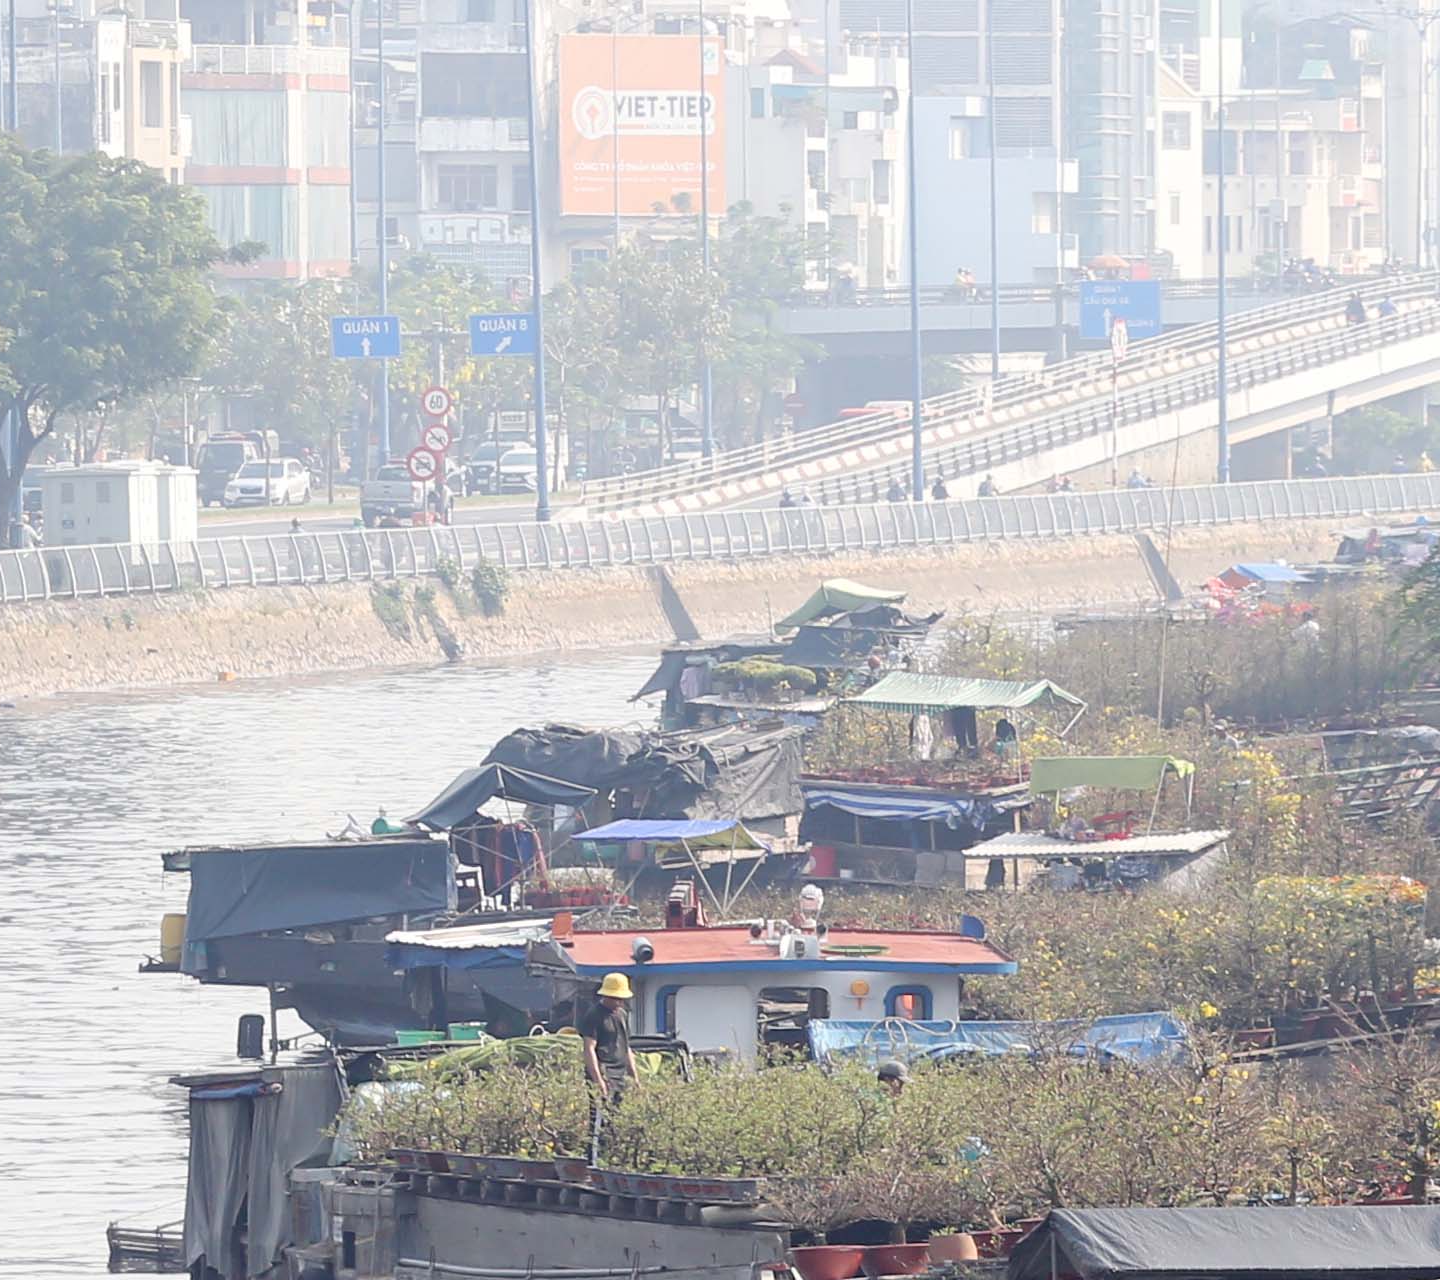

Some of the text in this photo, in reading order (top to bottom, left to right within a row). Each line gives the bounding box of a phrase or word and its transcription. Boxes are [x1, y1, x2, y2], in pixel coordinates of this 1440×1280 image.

[342, 319, 389, 337] QUẬN 1
[479, 317, 528, 335] QUẬN 8
